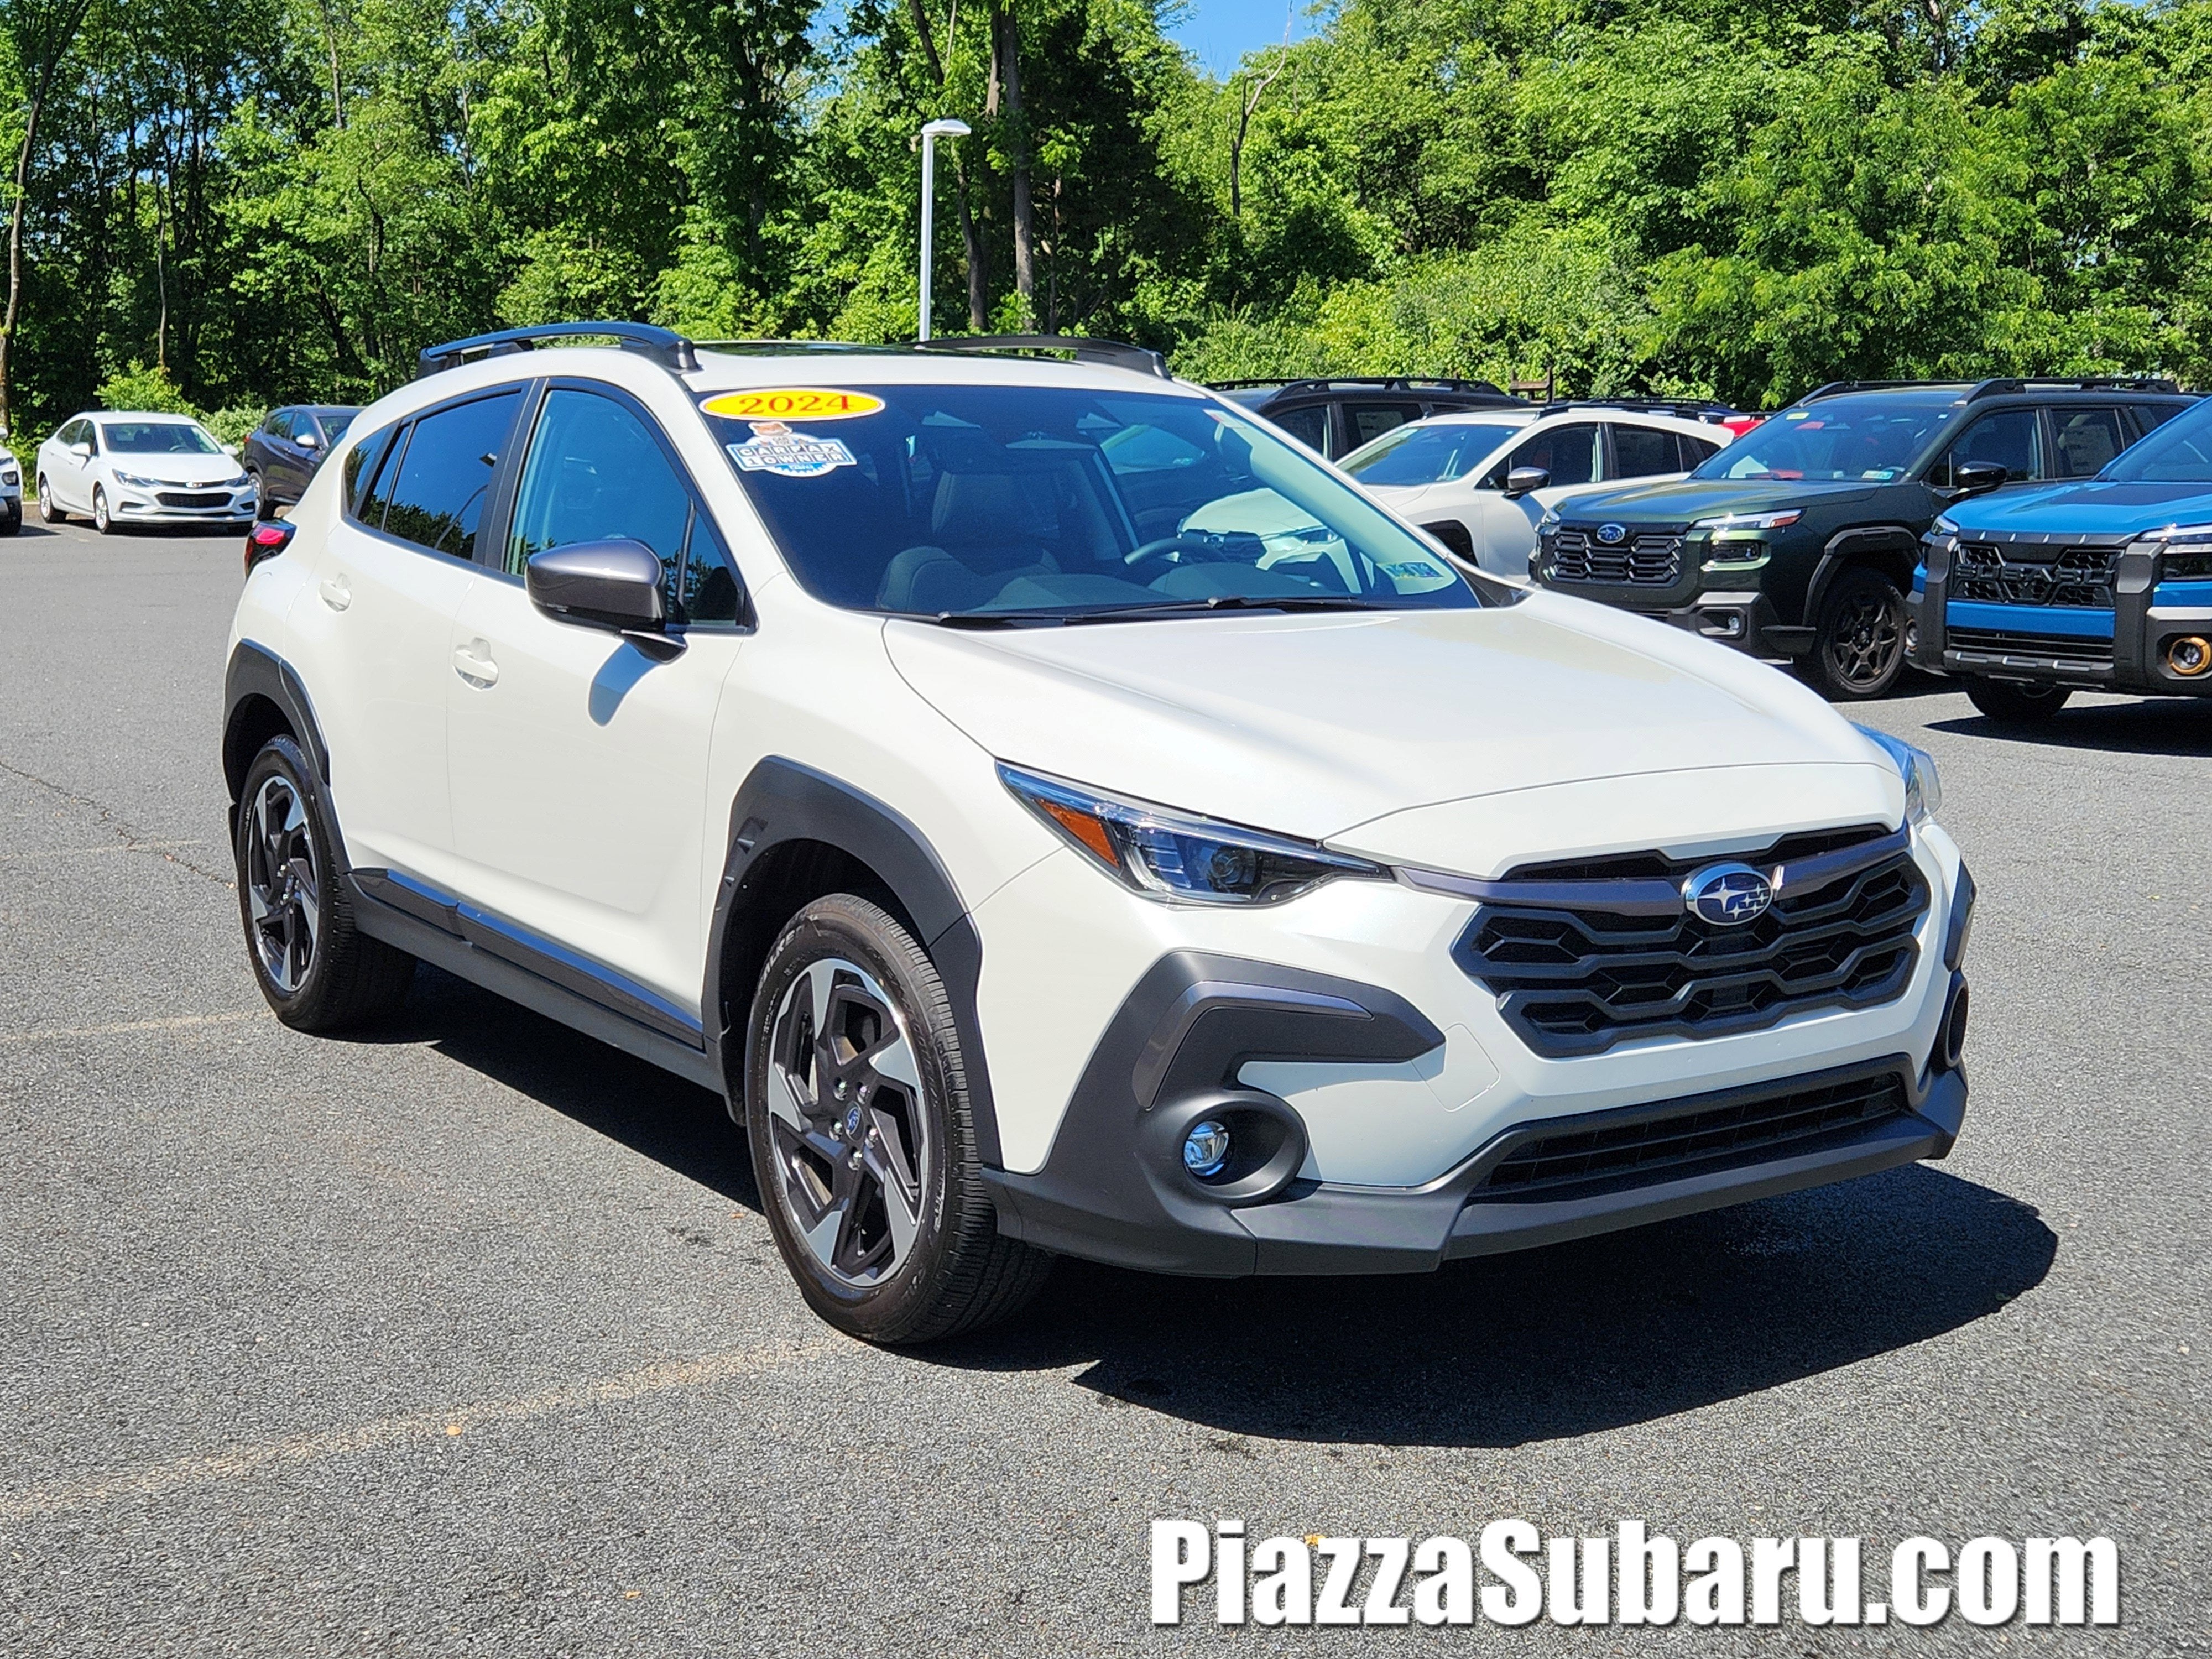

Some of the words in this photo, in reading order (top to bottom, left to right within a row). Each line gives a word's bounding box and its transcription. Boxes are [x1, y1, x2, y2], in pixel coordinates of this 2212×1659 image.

[739, 394, 854, 415] 2024
[740, 445, 837, 457] CARFAX
[762, 453, 845, 465] OWNER
[1955, 564, 2116, 584] SUBARU
